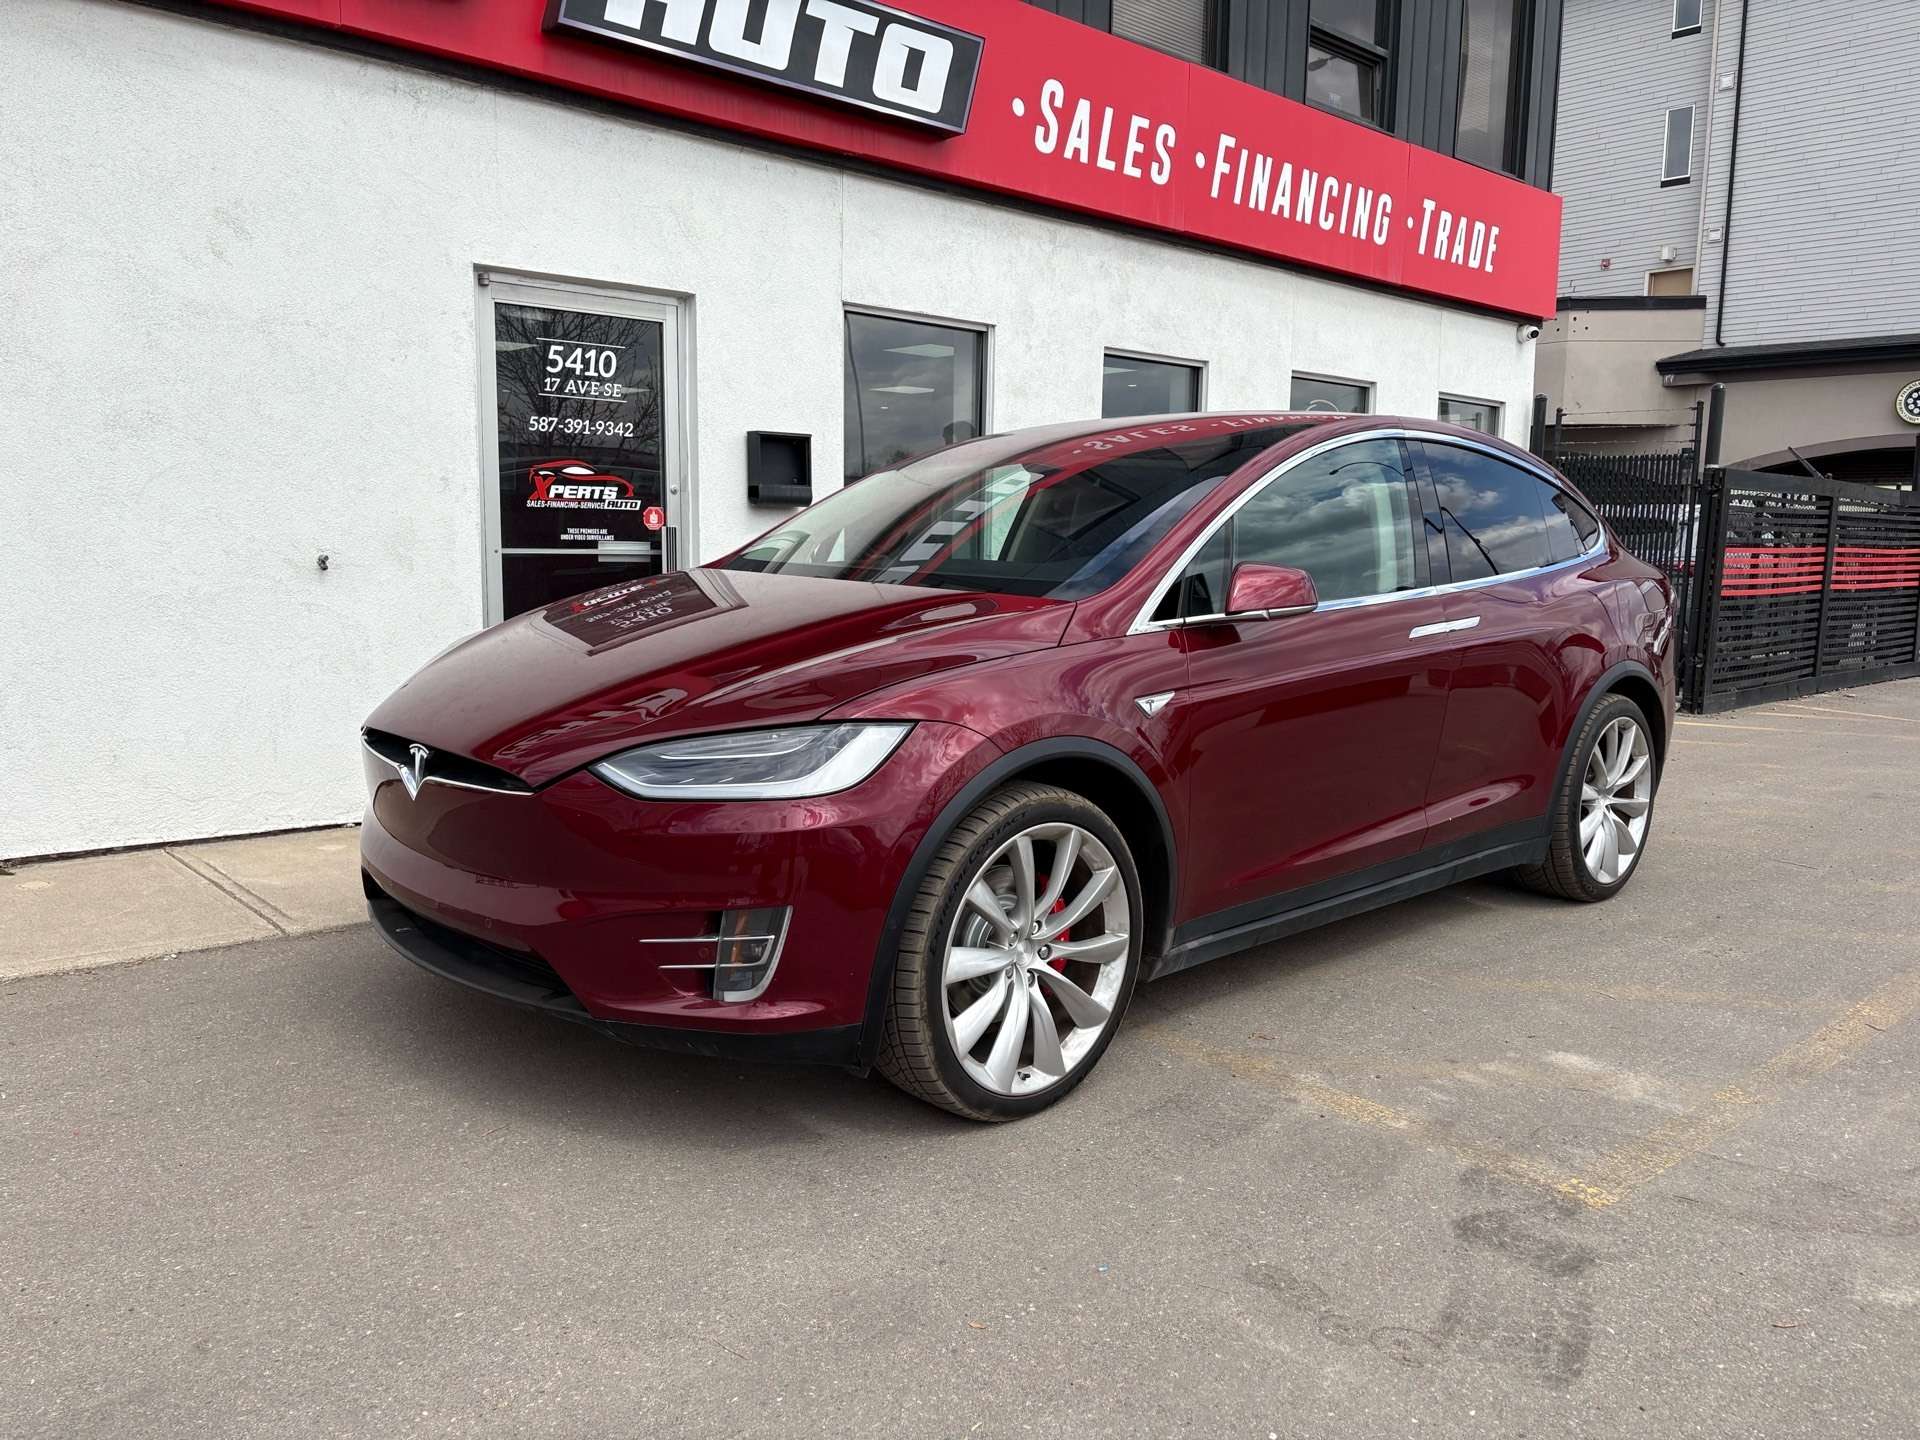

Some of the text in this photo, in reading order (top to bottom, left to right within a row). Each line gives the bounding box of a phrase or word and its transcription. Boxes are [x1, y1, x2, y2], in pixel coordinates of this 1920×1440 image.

[1035, 78, 1500, 273] SALES FINANCING TRADE
[546, 345, 617, 378] 5410
[544, 377, 622, 397] 17 AVE SE
[528, 416, 634, 438] 587-391-9342
[529, 475, 618, 500] XPERTS
[606, 500, 638, 510] AUTO
